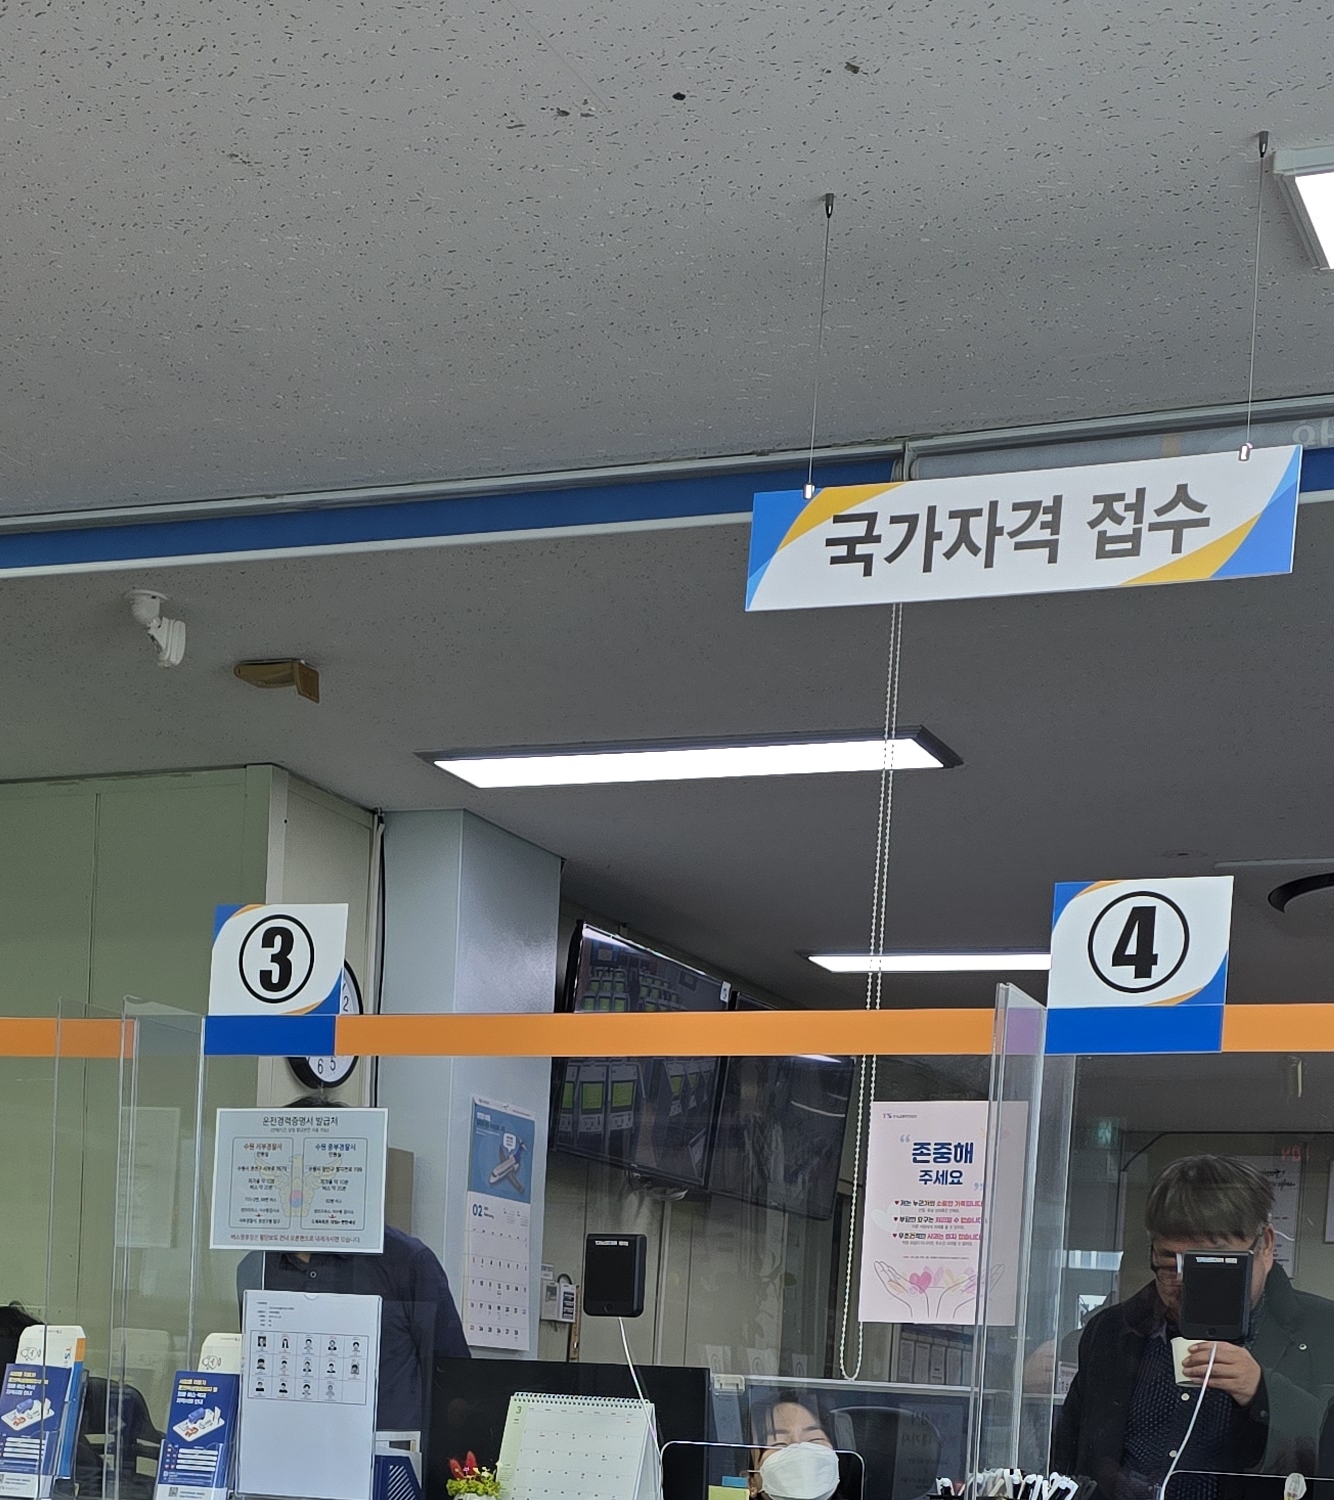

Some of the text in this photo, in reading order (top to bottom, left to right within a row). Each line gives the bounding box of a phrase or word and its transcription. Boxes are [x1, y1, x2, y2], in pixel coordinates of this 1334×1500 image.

[824, 481, 1213, 579] 국가자격 접수
[911, 1141, 974, 1165] 존중해
[918, 1169, 964, 1186] 주세요
